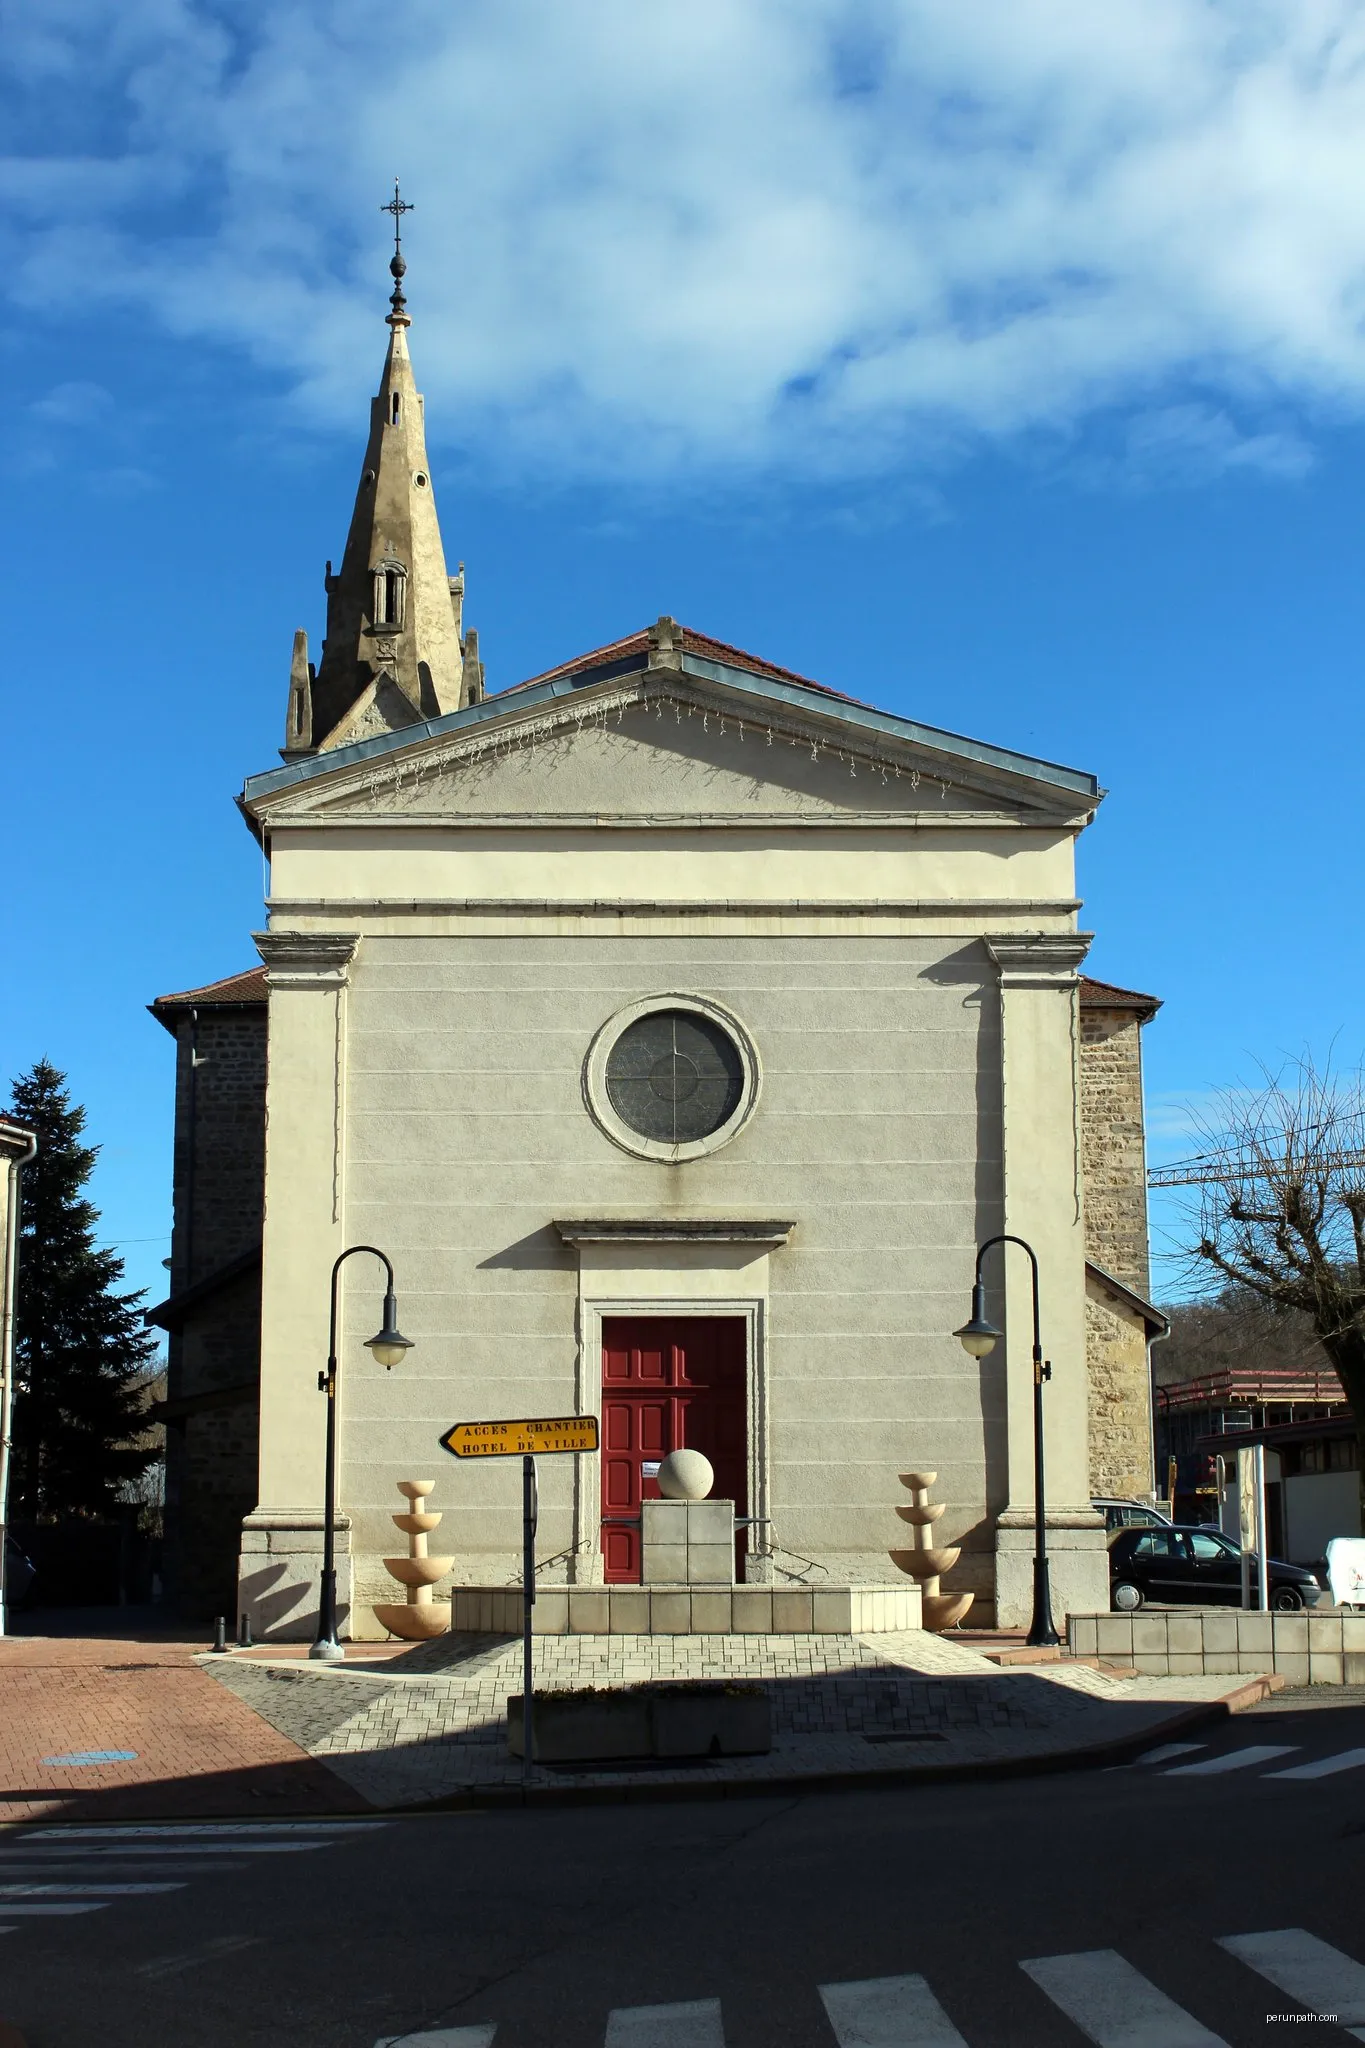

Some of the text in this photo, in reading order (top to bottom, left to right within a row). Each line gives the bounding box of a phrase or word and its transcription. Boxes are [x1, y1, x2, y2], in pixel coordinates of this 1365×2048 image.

[464, 1420, 595, 1437] ACCES CHANTIER
[462, 1438, 587, 1454] HOTEL DE VILLE
